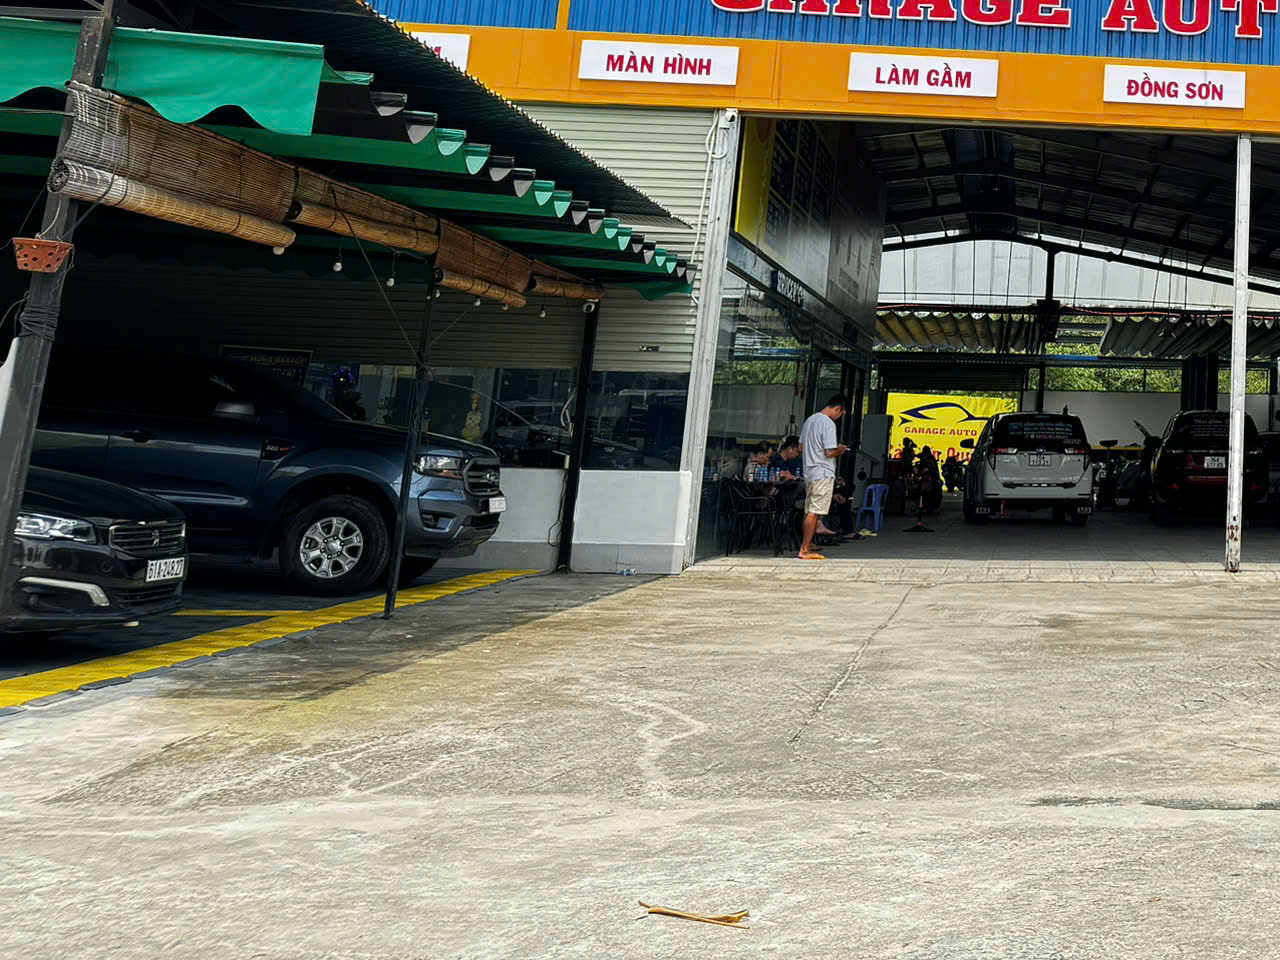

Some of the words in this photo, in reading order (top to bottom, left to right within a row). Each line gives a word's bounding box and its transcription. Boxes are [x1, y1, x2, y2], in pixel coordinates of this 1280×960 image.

[605, 50, 655, 74] MÀN
[663, 52, 712, 76] HÌNH
[874, 63, 919, 86] LÀM
[926, 61, 972, 89] GẦM
[1126, 72, 1179, 99] ĐỒNG
[1186, 80, 1224, 101] SƠN
[904, 426, 946, 436] GARAGE
[949, 428, 977, 437] AUTO
